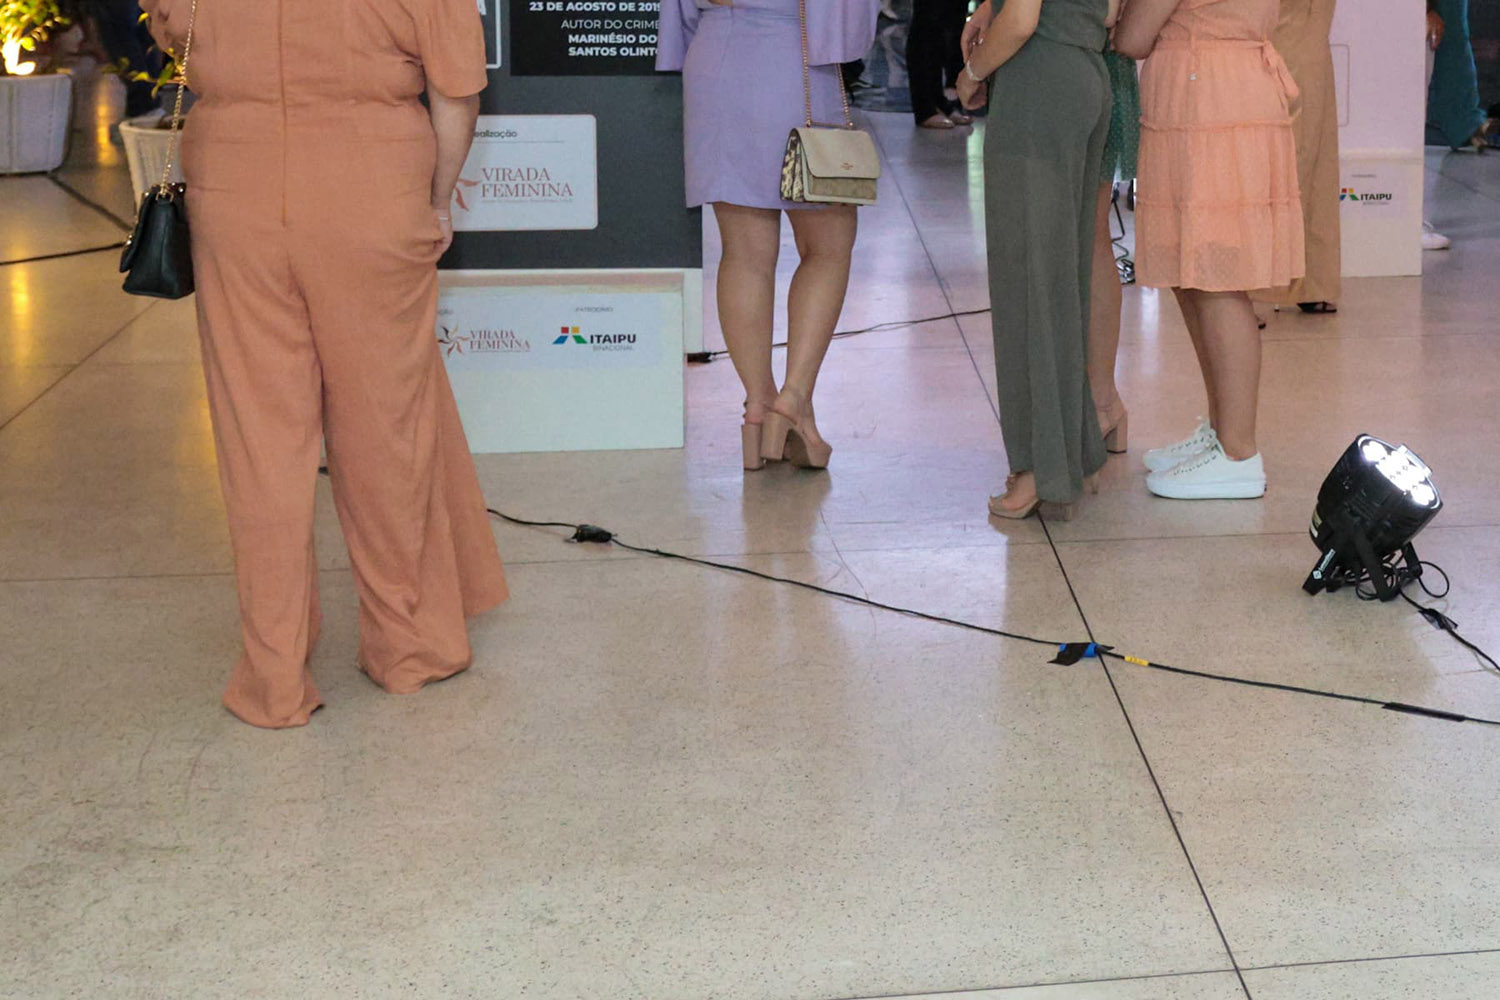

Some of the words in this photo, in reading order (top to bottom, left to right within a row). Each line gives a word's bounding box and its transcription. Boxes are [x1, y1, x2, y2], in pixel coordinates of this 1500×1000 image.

[529, 2, 544, 11] 23
[546, 2, 563, 11] DE
[566, 2, 616, 12] AGOSTO
[619, 2, 635, 12] DE
[561, 20, 601, 29] AUTOR
[604, 20, 622, 29] DO
[568, 32, 636, 44] MARINÉSIO
[639, 34, 657, 44] DO
[568, 47, 617, 56] SANTOS
[620, 47, 658, 56] OLINT
[473, 129, 518, 139] ealização
[482, 167, 550, 181] VIRADA
[481, 182, 573, 198] FEMININA
[470, 330, 515, 339] VIRADA
[590, 334, 636, 344] ITAIPU
